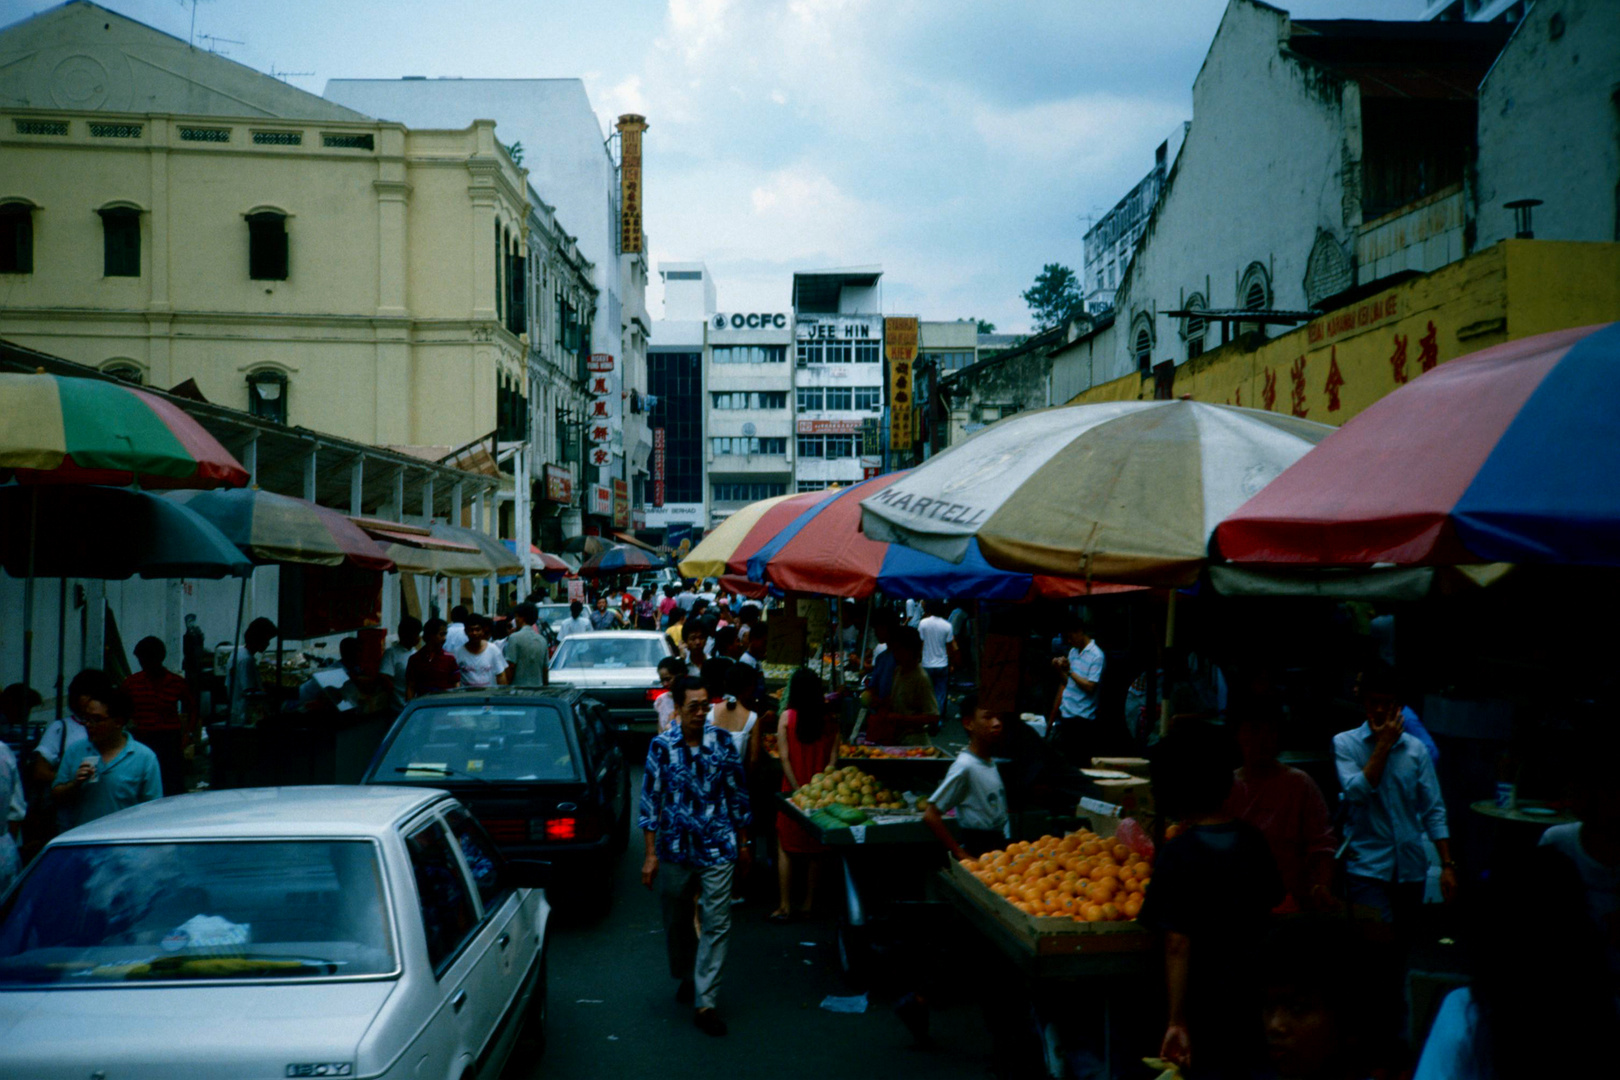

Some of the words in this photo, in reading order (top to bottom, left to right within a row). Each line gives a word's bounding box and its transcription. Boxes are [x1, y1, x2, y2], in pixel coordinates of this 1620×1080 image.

[731, 313, 786, 328] OCFC
[808, 325, 836, 339] JEE
[845, 325, 869, 338] HIN
[872, 488, 986, 526] MARTELL
